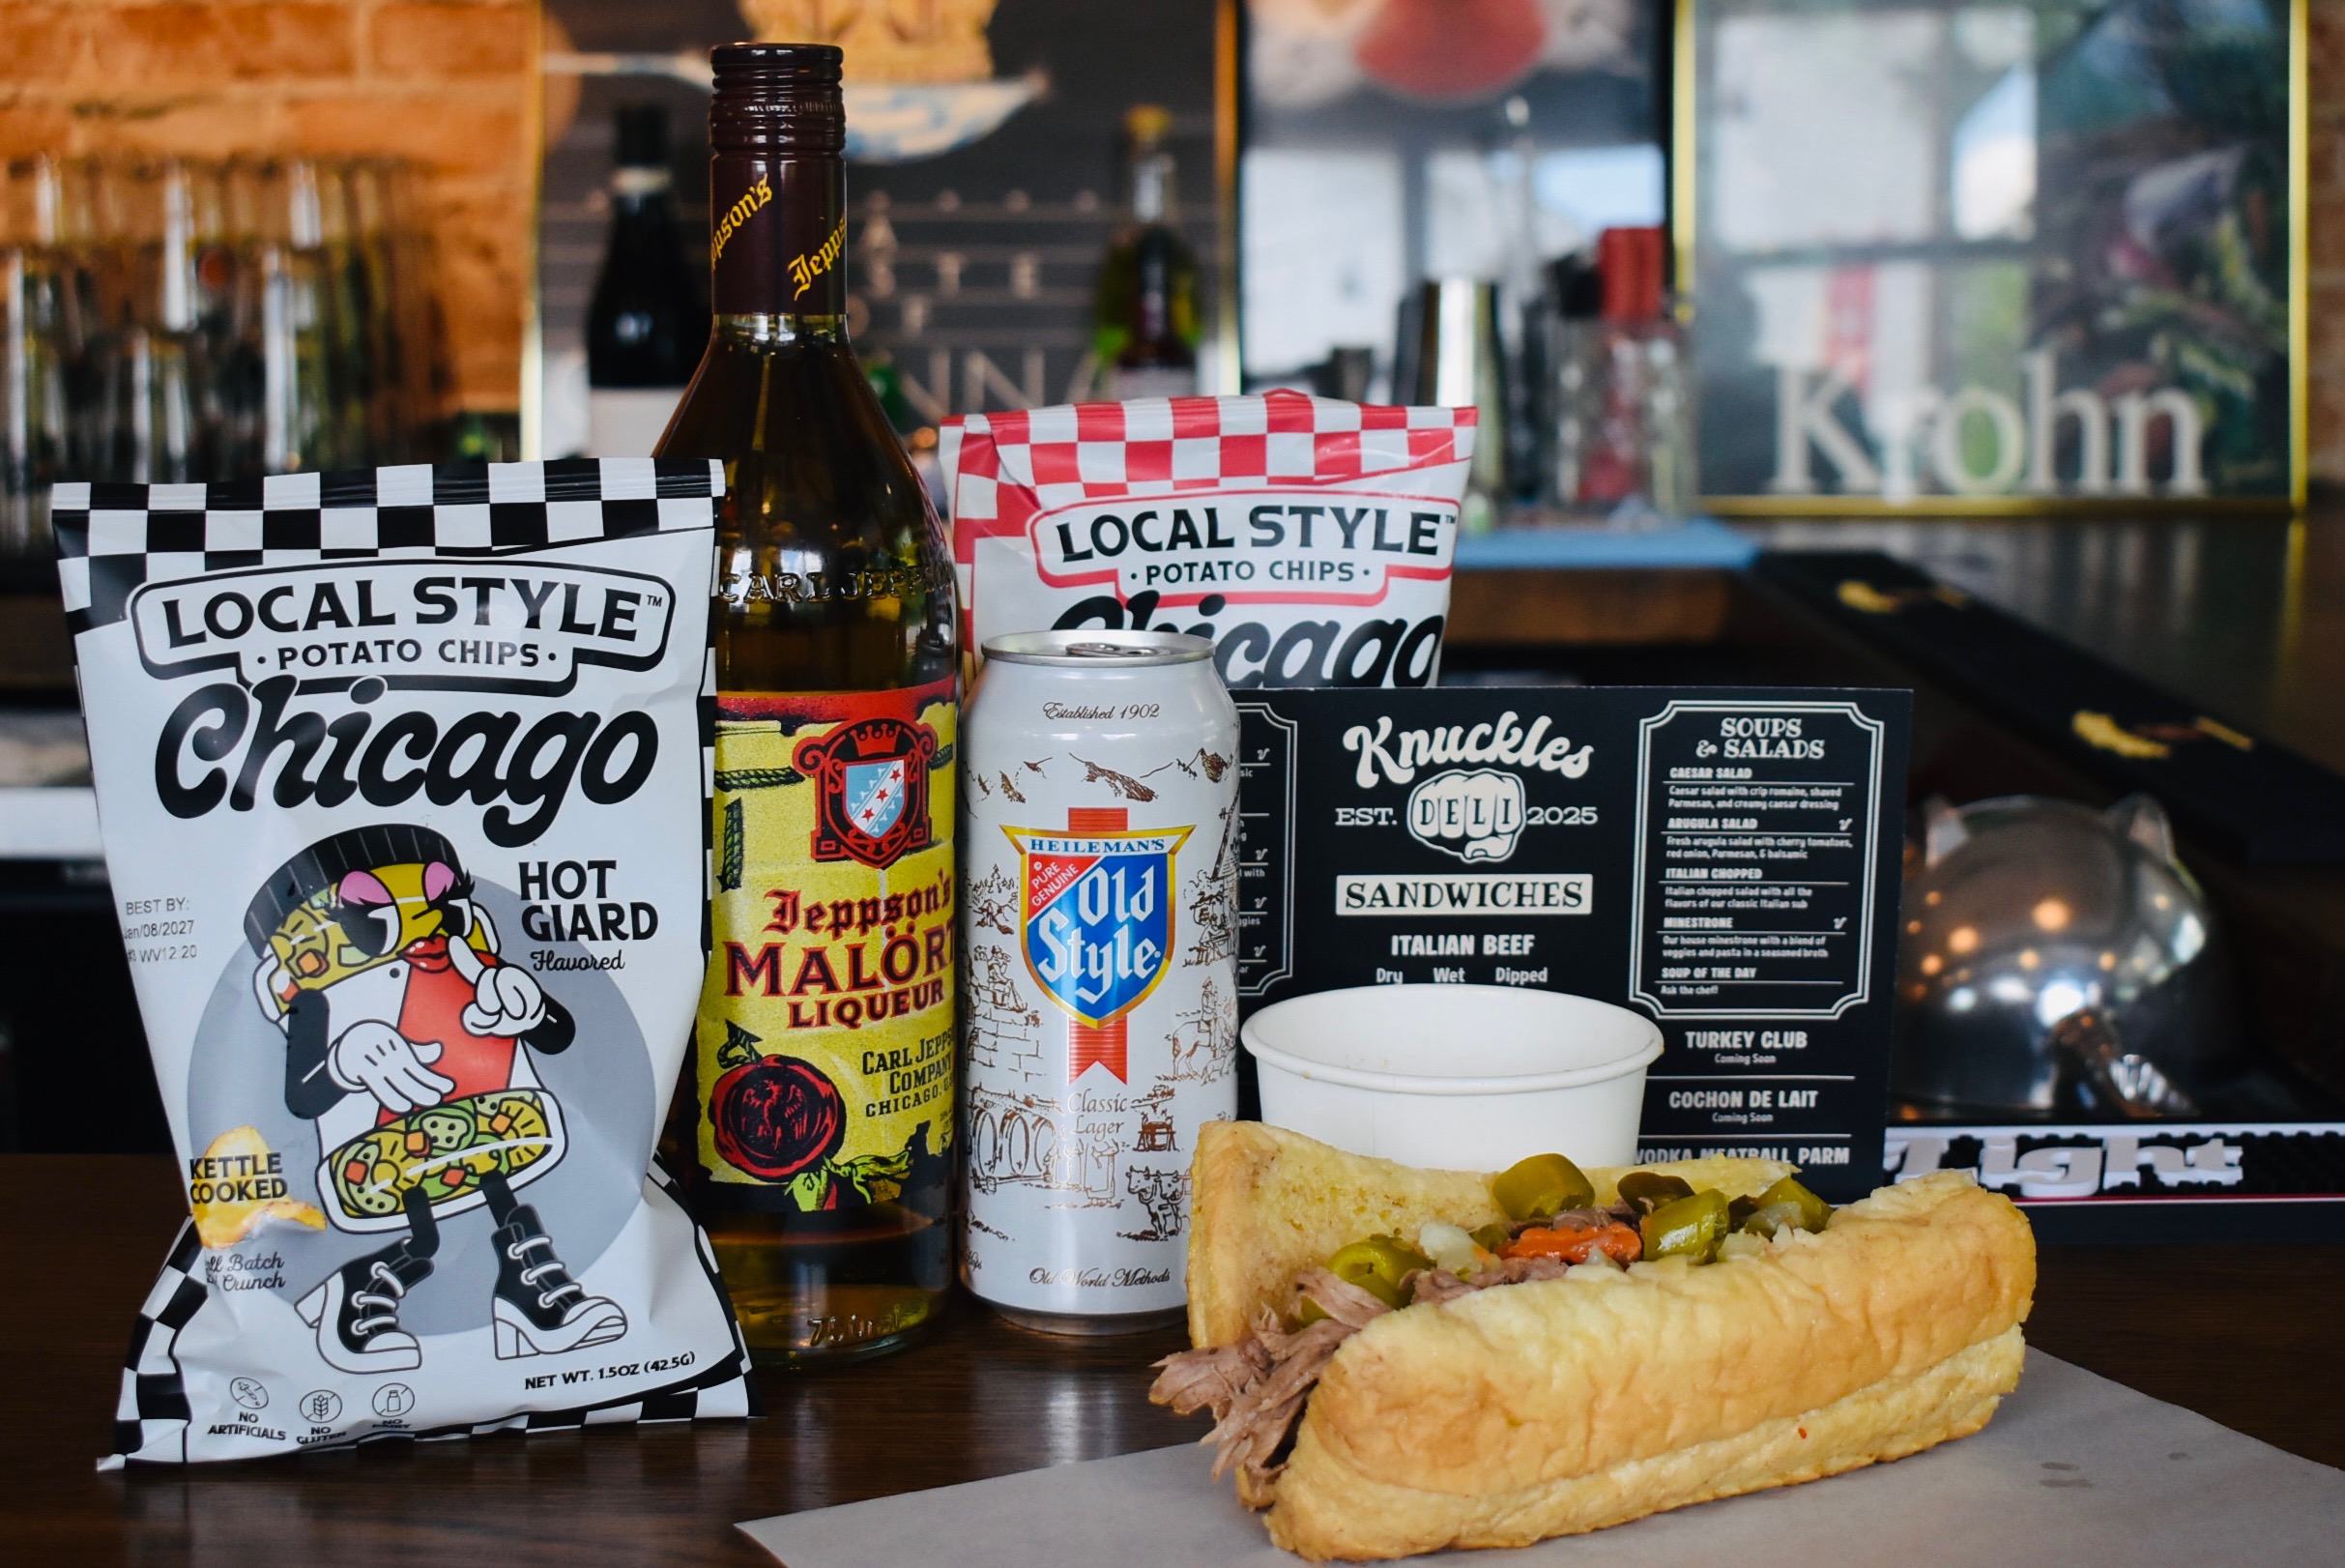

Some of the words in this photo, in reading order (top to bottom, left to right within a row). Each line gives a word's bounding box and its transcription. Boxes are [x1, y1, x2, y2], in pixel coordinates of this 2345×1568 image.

[1769, 350, 2208, 501] Krohn
[1057, 508, 1235, 563] LOCAL
[1146, 561, 1256, 585] POTATO
[1269, 561, 1354, 582] CHIPS
[160, 579, 395, 650] LOCAL
[277, 638, 421, 671] POTATO
[438, 639, 539, 667] CHIPS
[1043, 702, 1115, 719] Established
[1120, 703, 1160, 719] 1902
[1720, 717, 1802, 738] SOUPS
[1343, 711, 1595, 789] Knuckles
[1695, 740, 1718, 759] &
[1723, 739, 1825, 759] SALADS
[155, 675, 659, 847] Chicago
[1669, 768, 1713, 779] CAESAR
[1716, 768, 1752, 779] SALAD
[1669, 786, 1698, 797] Caesar
[1701, 786, 1724, 797] salad
[1726, 786, 1749, 797] with
[1335, 807, 1398, 826] EST.
[1420, 799, 1512, 826] DELI
[1526, 806, 1598, 825] 2025
[1716, 799, 1732, 808] and
[1734, 799, 1767, 810] creamy
[1768, 800, 1797, 809] caesar
[1799, 799, 1838, 810] dressing
[1667, 818, 1719, 829] ARUGULA
[1722, 818, 1758, 829] SALAD
[1030, 838, 1165, 853] HEILEMAN'S
[1666, 836, 1691, 846] Fresh
[1693, 836, 1726, 848] arugula
[1728, 836, 1752, 846] salad
[1754, 836, 1775, 846] with
[1666, 849, 1681, 859] red
[1768, 849, 1808, 859] balsamic
[518, 859, 617, 900] HOT
[1031, 861, 1060, 889] PURE
[1665, 868, 1708, 879] ITALIAN
[1711, 868, 1763, 879] CHOPPED
[1031, 863, 1079, 907] GENUINE
[1665, 886, 1694, 896] Italian
[1696, 886, 1734, 898] chopped
[1735, 886, 1759, 896] salad
[1760, 886, 1782, 896] with
[1797, 886, 1812, 896] the
[762, 867, 951, 941] Jeppson's
[1079, 865, 1154, 926] Old
[1346, 882, 1583, 909] SANDWICHES
[1665, 899, 1696, 909] flavors
[1698, 899, 1709, 909] of
[1710, 899, 1725, 909] our
[1727, 899, 1758, 909] classic
[1760, 899, 1790, 909] Italian
[1791, 899, 1808, 909] sub
[126, 899, 161, 915] BEST
[166, 897, 189, 912] BY:
[521, 901, 658, 942] GIARD
[1664, 917, 1733, 928] MINESTRONE
[1391, 935, 1475, 956] ITALIAN
[1483, 934, 1535, 955] BEEF
[1663, 936, 1678, 945] Our
[1680, 936, 1706, 945] house
[1707, 936, 1757, 945] minestrone
[1759, 936, 1780, 945] with
[1789, 936, 1814, 945] blend
[1815, 936, 1826, 945] of
[530, 949, 625, 972] Flavored
[1663, 948, 1696, 959] veggies
[1698, 948, 1715, 958] and
[1716, 948, 1741, 959] pasta
[1743, 948, 1752, 958] in
[1760, 948, 1802, 958] seasoned
[1803, 948, 1829, 958] broth
[1375, 968, 1404, 984] Dry
[1433, 967, 1465, 983] Wet
[1495, 967, 1549, 985] Dipped
[1662, 968, 1691, 978] SOUP
[1694, 968, 1708, 978] OF
[1711, 968, 1731, 978] THE
[1734, 968, 1756, 978] DAY
[1661, 985, 1677, 995] Ask
[1679, 985, 1694, 995] the
[788, 976, 945, 1030] LIQUEUR
[1685, 1031, 1755, 1049] TURKEY
[1760, 1031, 1808, 1049] CLUB
[862, 1048, 912, 1075] CARL
[1714, 1053, 1751, 1065] Coming
[1752, 1054, 1777, 1063] Soon
[1068, 1089, 1127, 1113] Classic
[1669, 1090, 1743, 1109] COCHON
[1750, 1090, 1772, 1108] DE
[1778, 1090, 1819, 1108] LAIT
[1073, 1115, 1124, 1142] Lager
[1712, 1113, 1749, 1125] Coming
[1750, 1113, 1774, 1122] Soon
[189, 1152, 283, 1179] KETTLE
[1798, 1147, 1850, 1165] PARM
[1884, 1135, 2243, 1197] Light
[189, 1177, 288, 1205] COOKED
[227, 1251, 284, 1272] Batch
[223, 1271, 286, 1292] Crunch
[1029, 1267, 1055, 1284] Old
[1060, 1267, 1111, 1287] World
[1112, 1267, 1171, 1287] Methods
[525, 1375, 557, 1390] NET
[562, 1370, 593, 1385] WT.
[644, 1350, 696, 1373] (42.5G)
[239, 1411, 258, 1423] NO
[208, 1424, 286, 1441] ARTIFICIALS
[310, 1426, 332, 1436] NO
